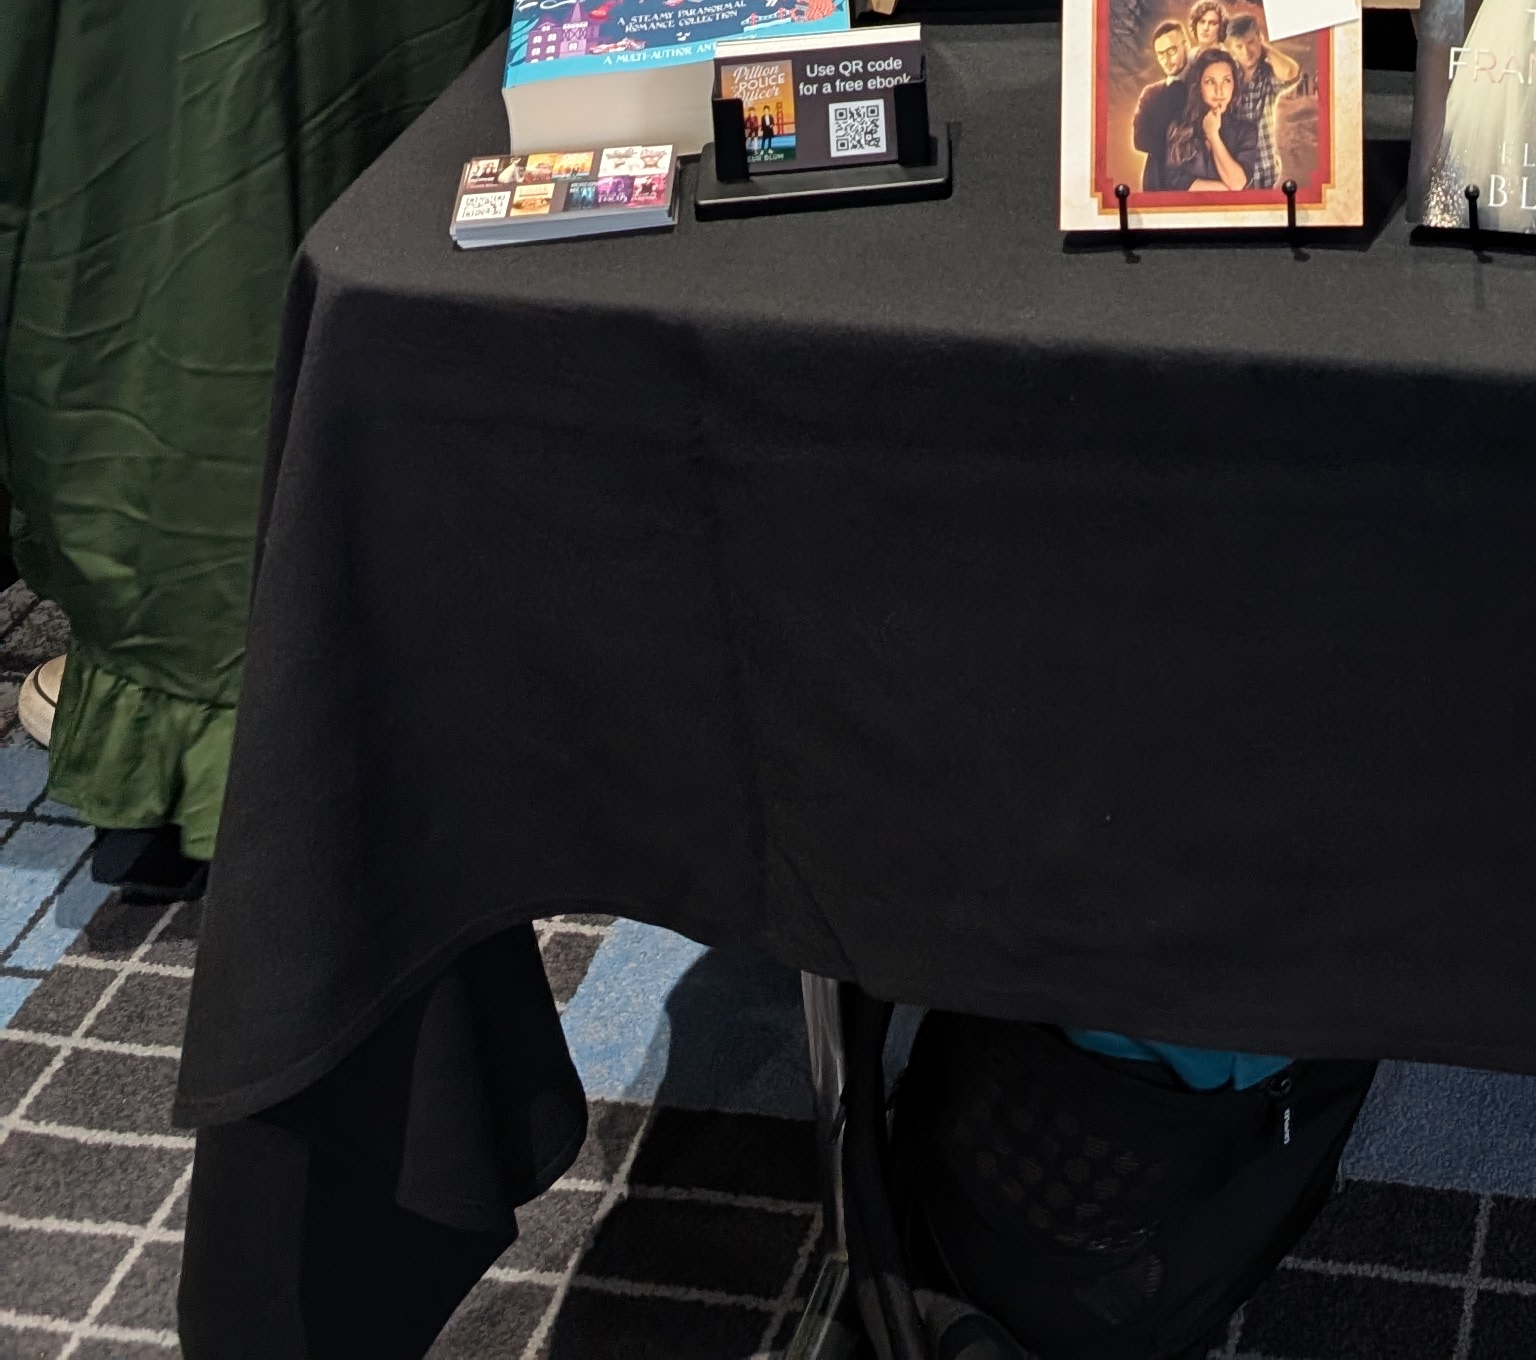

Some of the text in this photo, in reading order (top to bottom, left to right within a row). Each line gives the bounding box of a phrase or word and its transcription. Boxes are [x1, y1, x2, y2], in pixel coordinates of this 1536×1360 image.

[617, 0, 747, 26] A STEAMY PARANORMAL
[625, 10, 738, 33] ROMANCE COLLECTION
[603, 56, 613, 65] A
[616, 46, 692, 63] MULTI-AUTHOR
[732, 65, 780, 84] Pillion
[806, 57, 903, 77] Use QR code
[738, 73, 785, 93] POLICE
[799, 83, 818, 96] for
[822, 84, 832, 94] a
[836, 79, 863, 92] free
